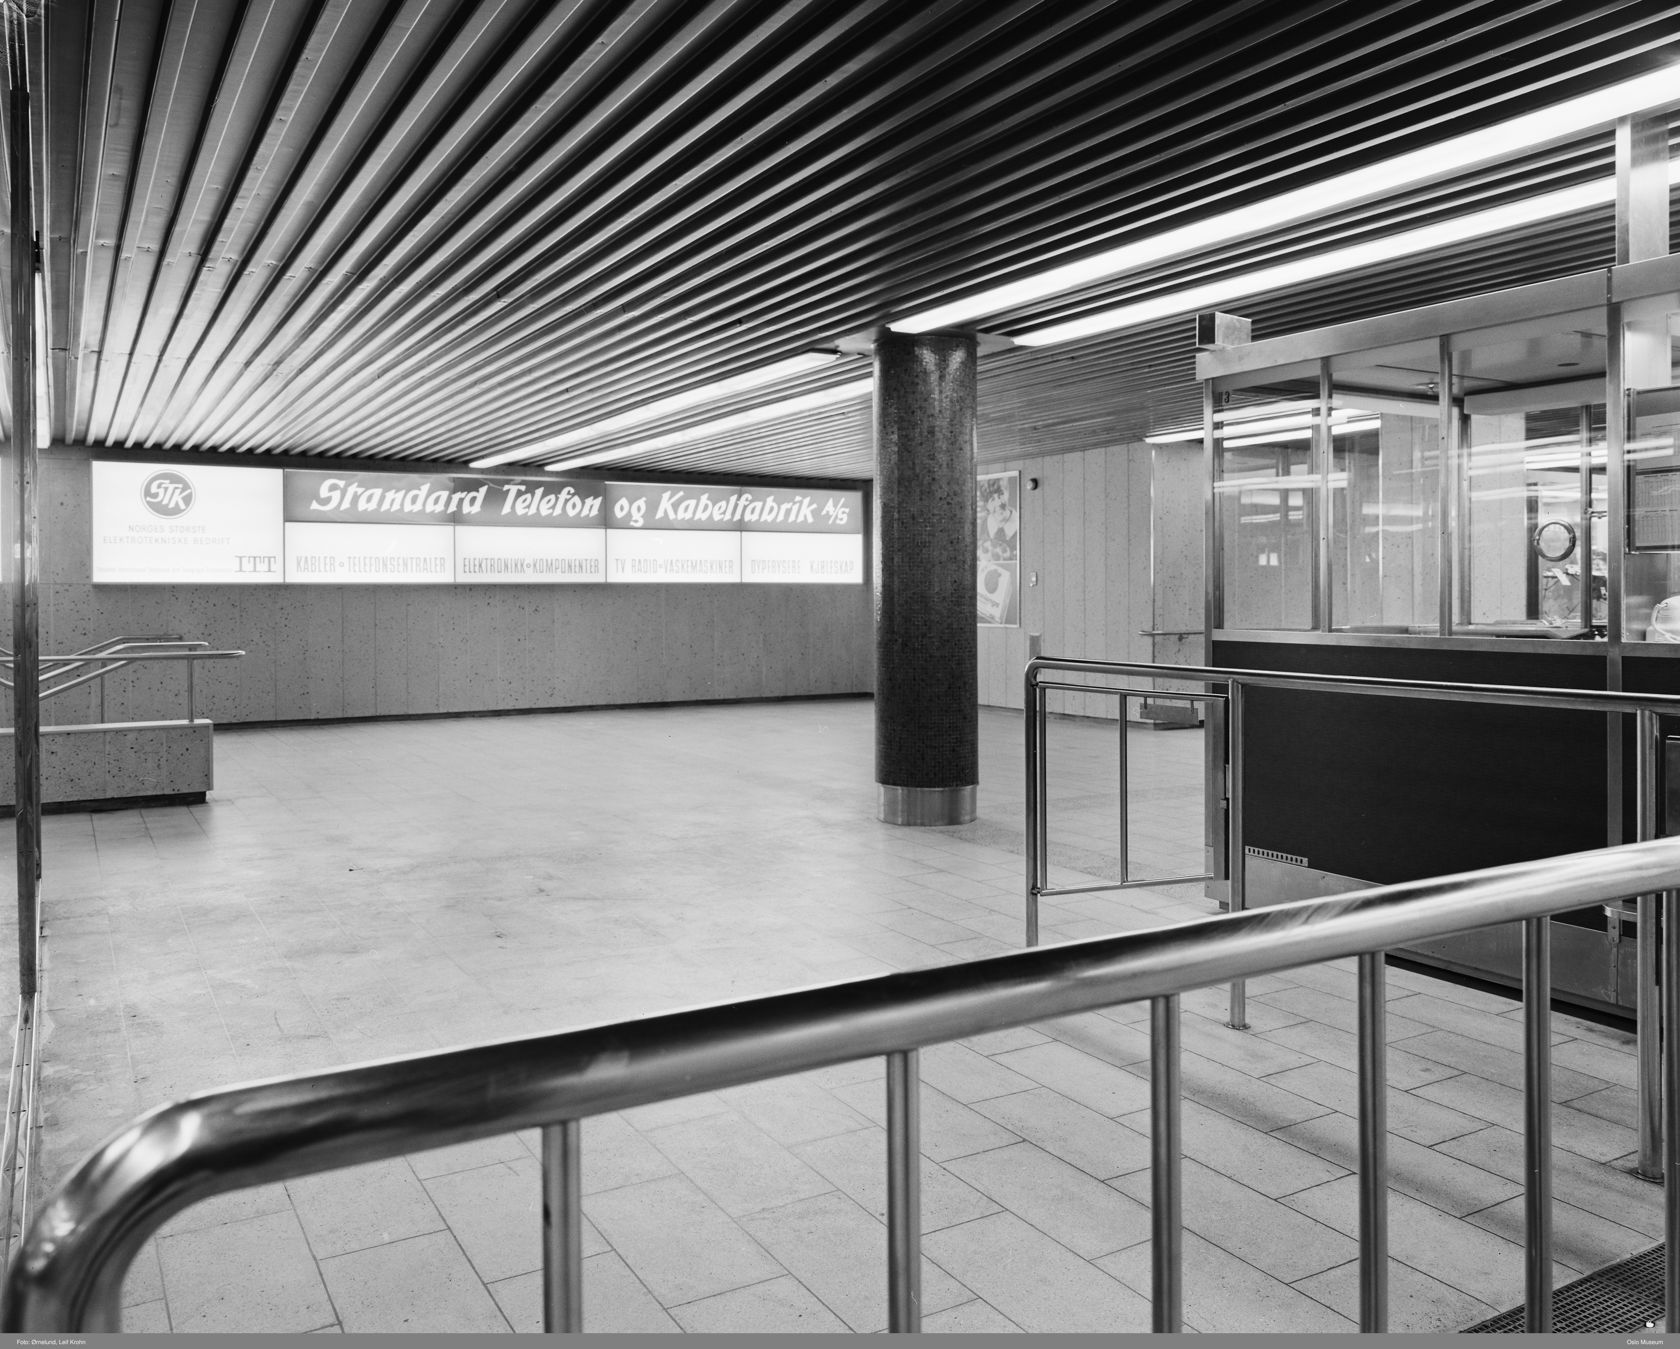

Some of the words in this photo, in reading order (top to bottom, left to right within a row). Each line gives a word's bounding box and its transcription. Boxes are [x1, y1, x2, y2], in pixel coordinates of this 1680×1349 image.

[1224, 391, 1230, 404] 3
[146, 479, 193, 510] STK
[310, 478, 488, 514] Standard
[501, 484, 602, 517] Telefon
[614, 496, 647, 527] og
[655, 490, 818, 524] Kabelfabrik
[821, 497, 850, 525] A/S
[128, 524, 165, 534] NORGES
[168, 525, 206, 534] STØRSTE
[103, 536, 189, 545] ELEKTROTEKNISKE
[192, 536, 231, 545] BEDRIFT
[234, 555, 277, 573] ITT
[296, 555, 336, 573] KABLER
[347, 556, 446, 574] TELEFONSENTRALER
[463, 557, 526, 574] ELEKTRONIKK
[532, 558, 600, 574] KOMPONENTER
[614, 558, 626, 574] TV
[631, 558, 658, 574] RADIO
